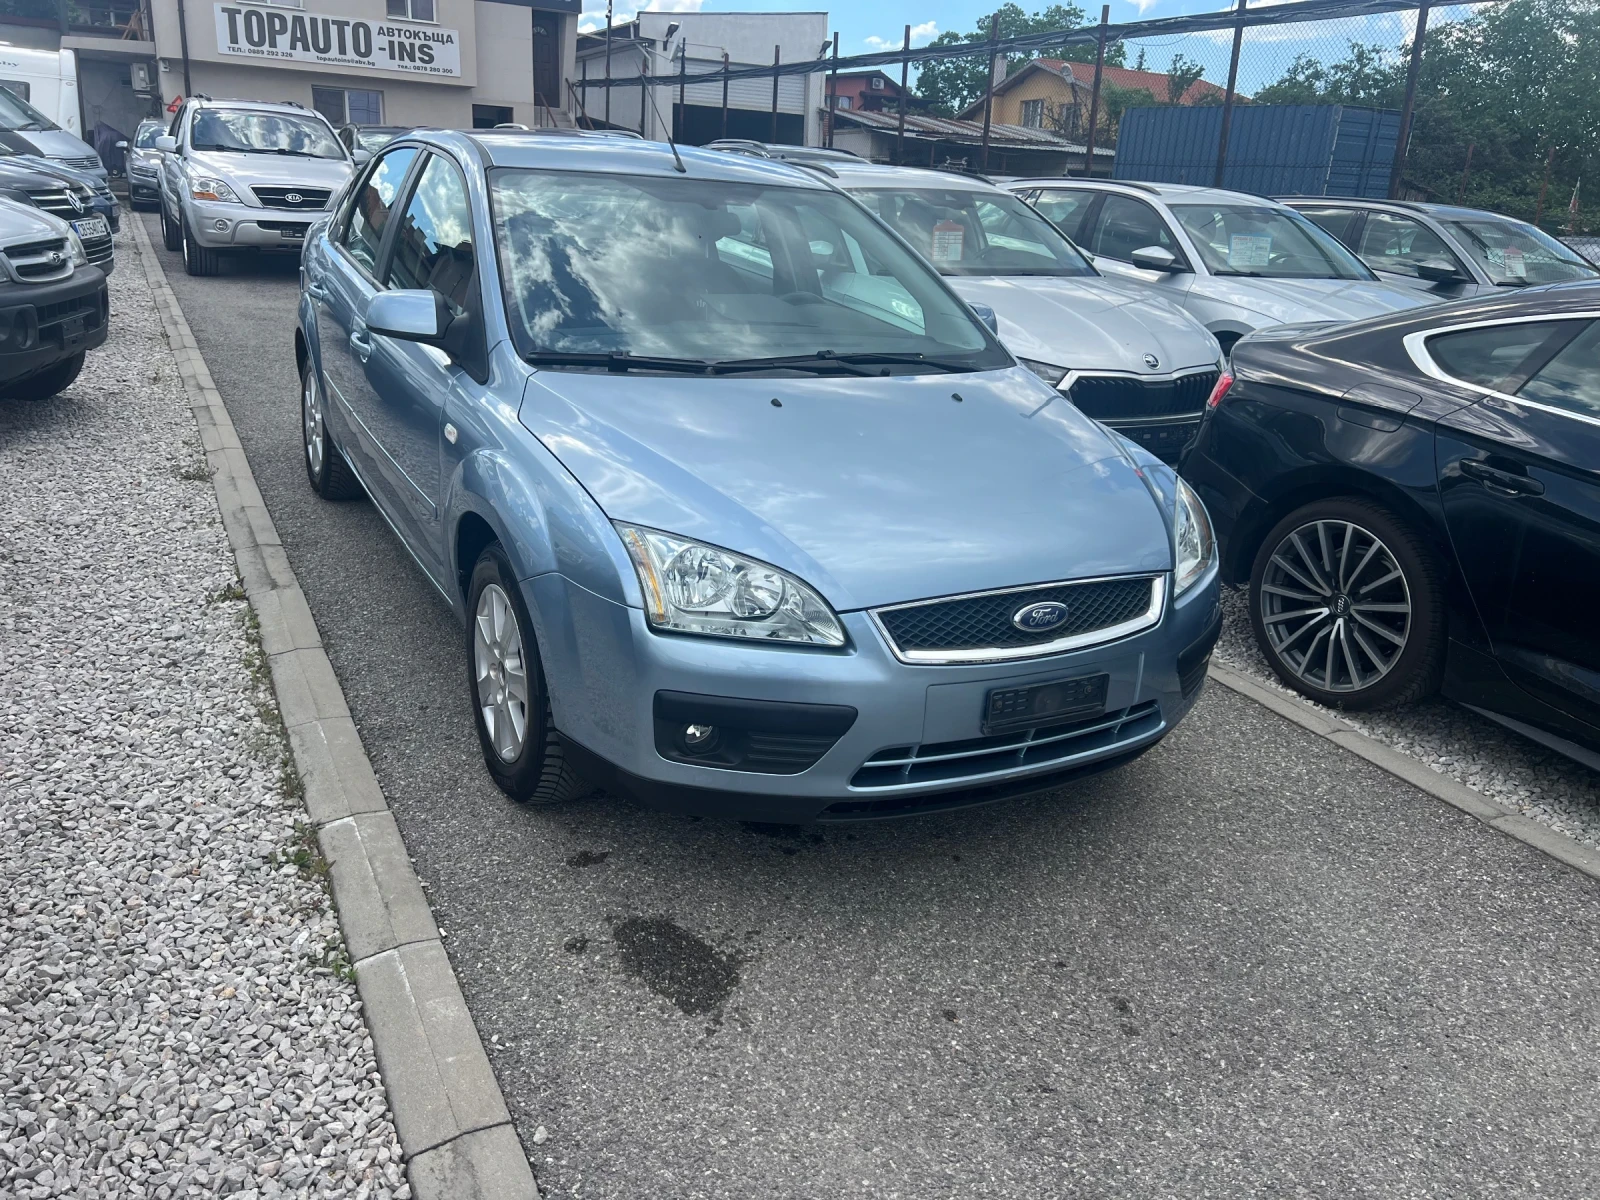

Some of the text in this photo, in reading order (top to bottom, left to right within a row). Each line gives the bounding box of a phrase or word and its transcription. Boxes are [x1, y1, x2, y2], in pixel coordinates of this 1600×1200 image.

[221, 7, 372, 58] TOPAUTO
[377, 26, 454, 45] АВТОКЪЩА
[1029, 608, 1059, 626] Ford
